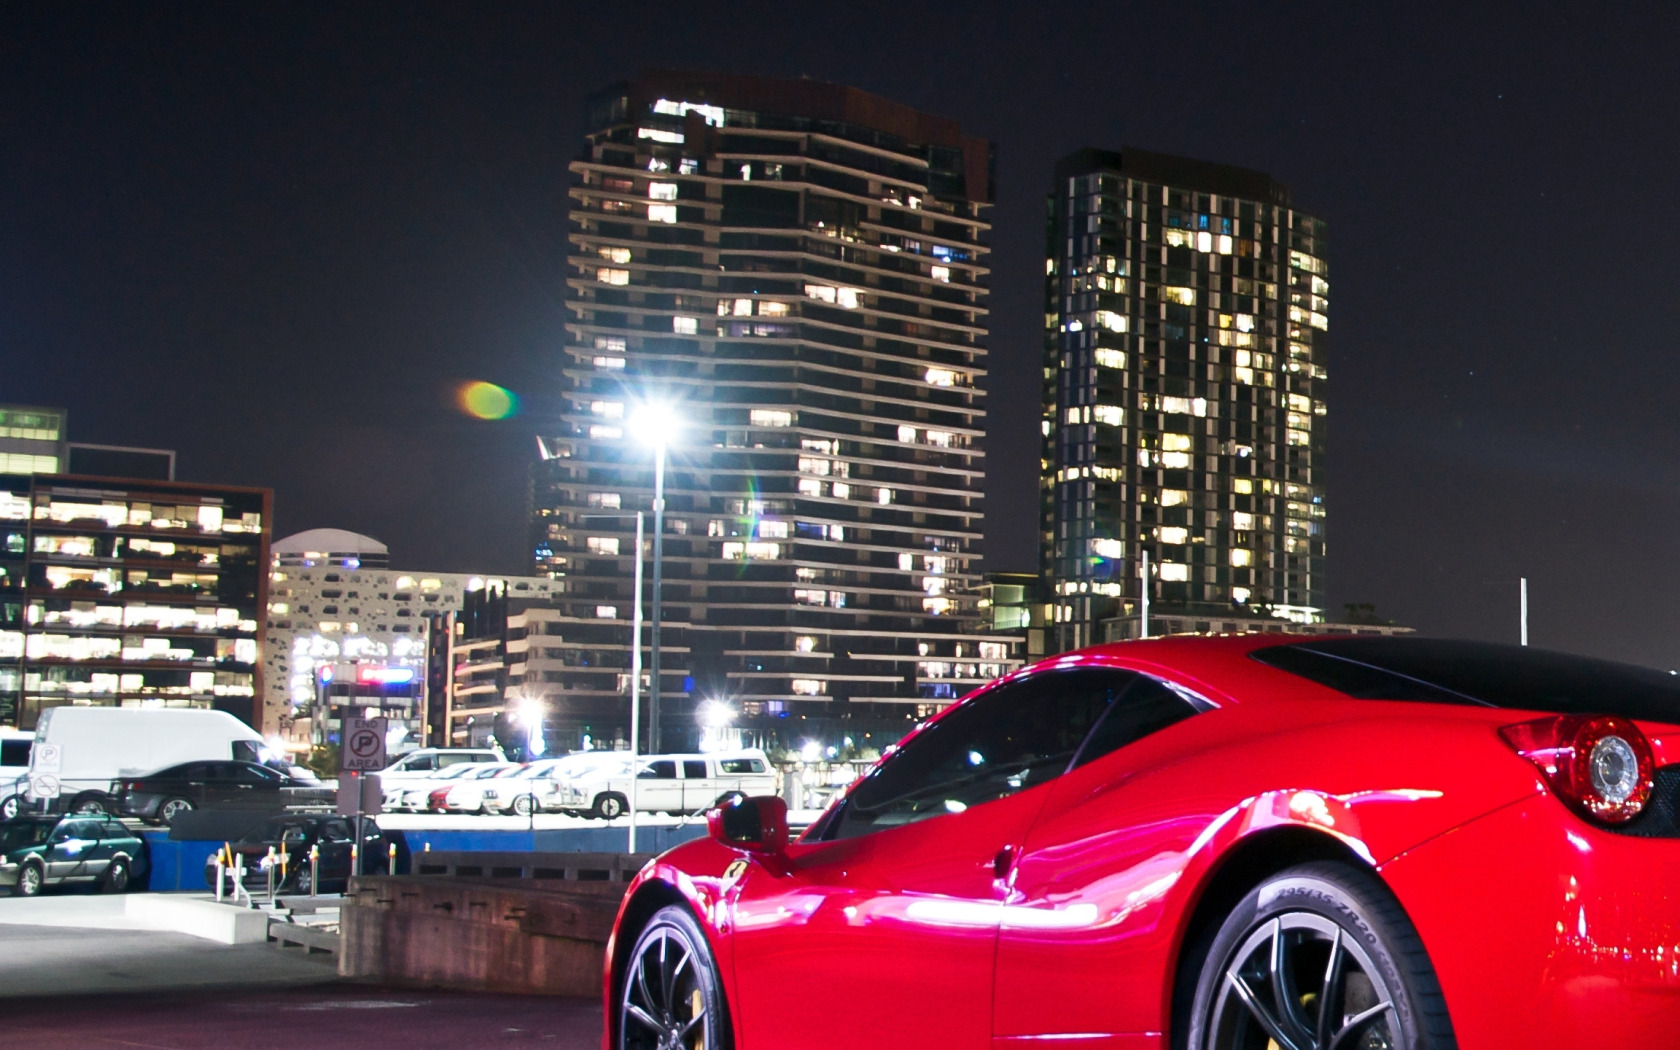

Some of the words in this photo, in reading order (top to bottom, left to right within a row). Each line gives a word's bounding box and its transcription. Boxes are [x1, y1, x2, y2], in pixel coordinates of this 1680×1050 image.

[354, 719, 379, 728] END
[348, 758, 380, 768] AREA
[1336, 902, 1377, 944] ZR20
